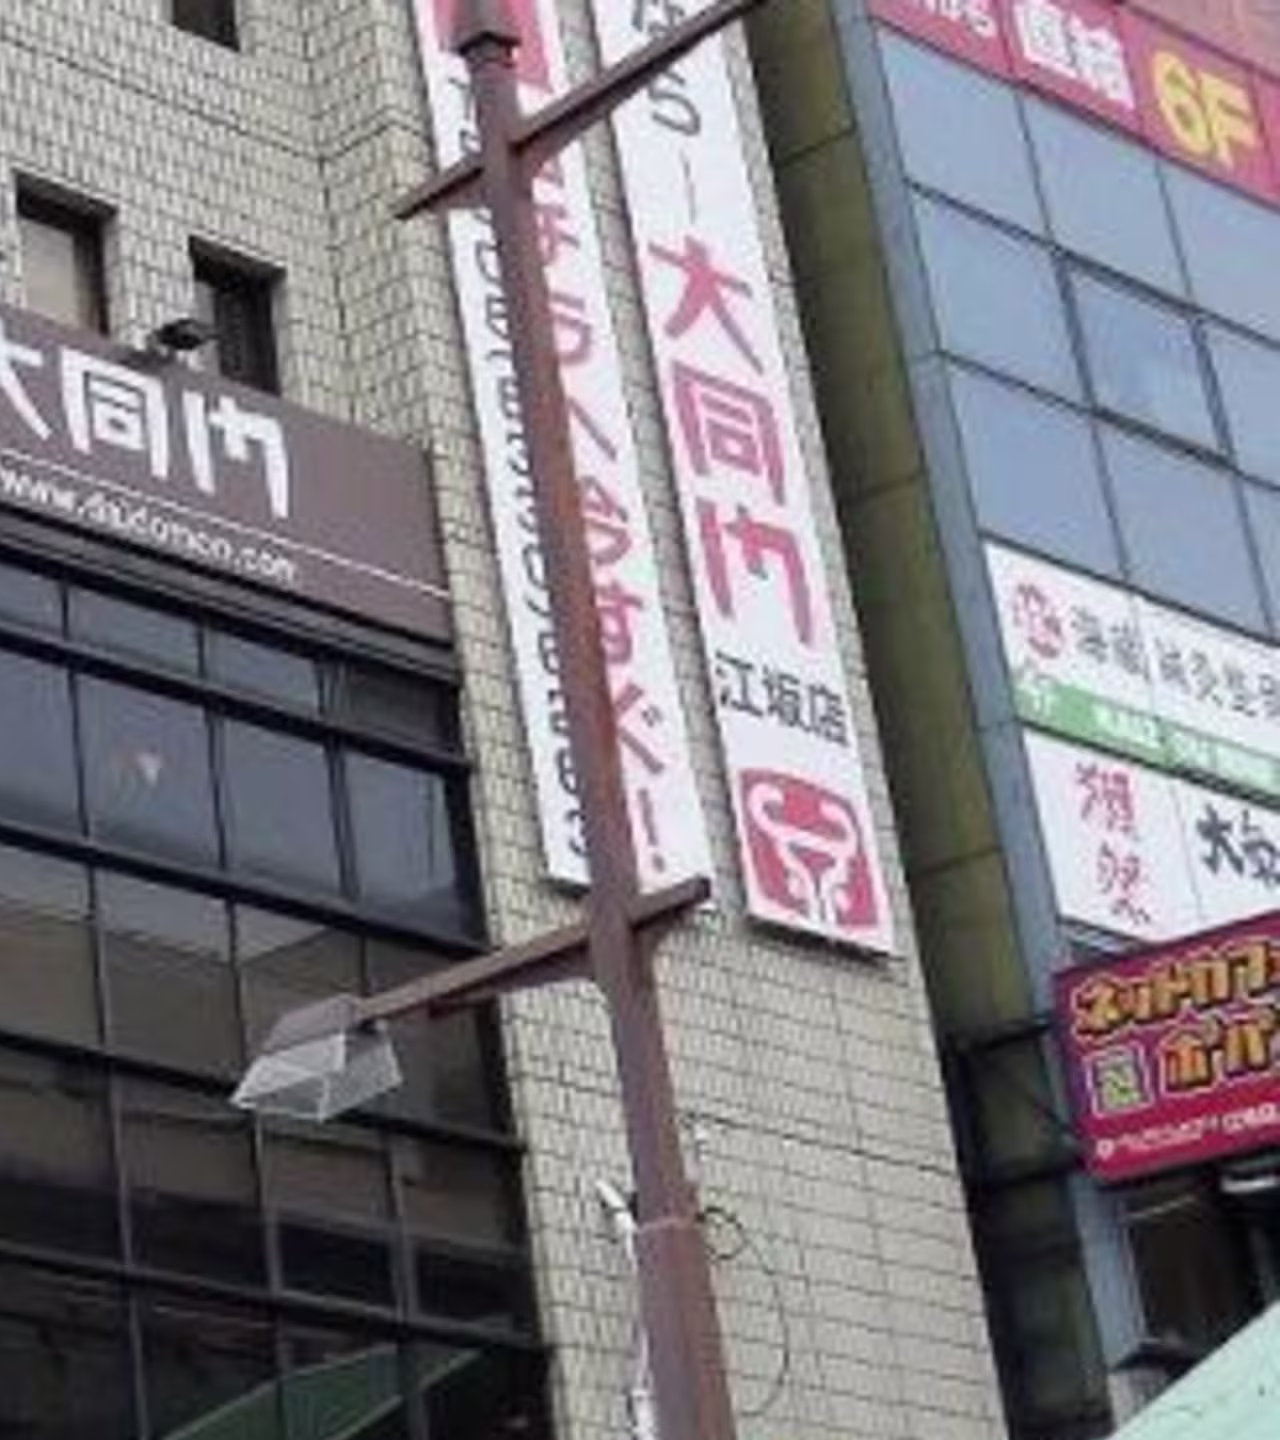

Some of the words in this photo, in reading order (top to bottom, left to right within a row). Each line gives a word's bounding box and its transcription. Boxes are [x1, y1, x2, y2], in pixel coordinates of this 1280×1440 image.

[1150, 51, 1261, 169] 6F
[715, 649, 850, 747] 江坂店
